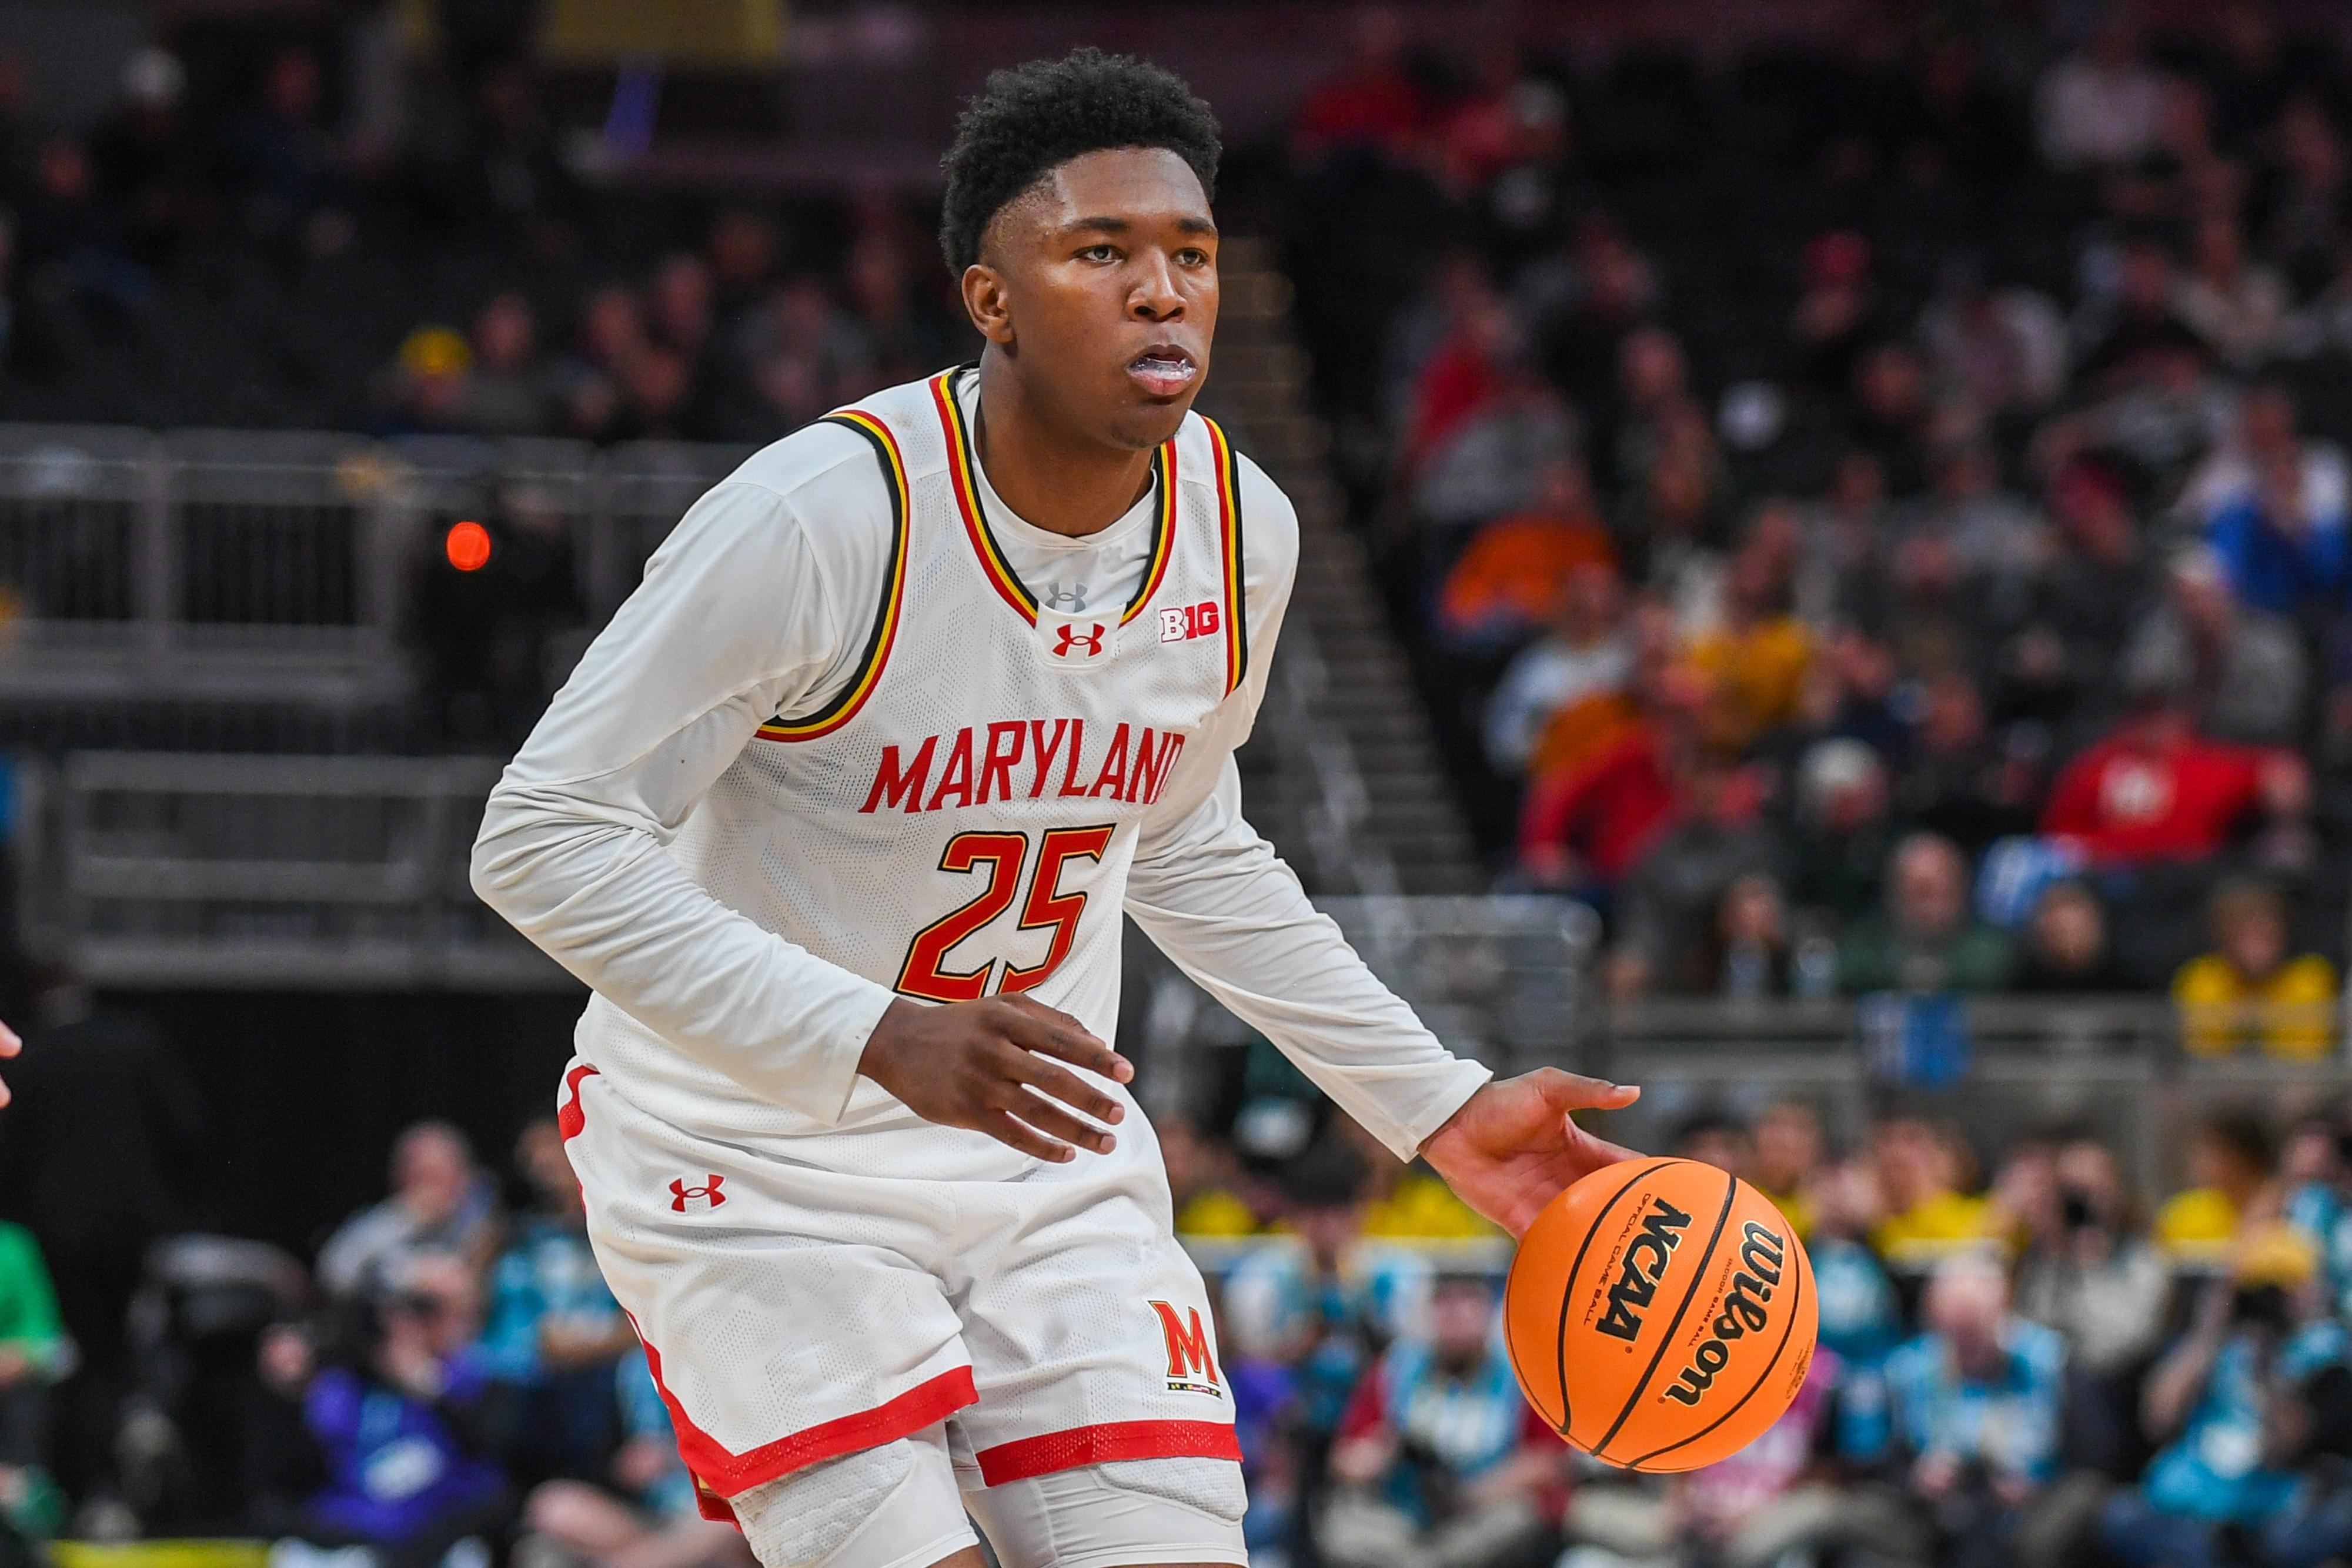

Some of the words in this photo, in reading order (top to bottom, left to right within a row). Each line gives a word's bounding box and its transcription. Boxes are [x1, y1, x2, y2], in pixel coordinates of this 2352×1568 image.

[857, 718, 1185, 814] MARYLAND
[893, 823, 1117, 1003] 25
[1618, 1193, 1652, 1242] OFFICIAL
[1595, 1197, 1693, 1342] NCAA
[1599, 1245, 1621, 1286] GAME
[1717, 1258, 1733, 1293] INDOOR
[1583, 1288, 1602, 1326] BALL
[1665, 1220, 1785, 1407] Wilson
[1703, 1296, 1719, 1323] GAME
[1147, 1300, 1220, 1387] M
[1688, 1325, 1704, 1347] BALL
